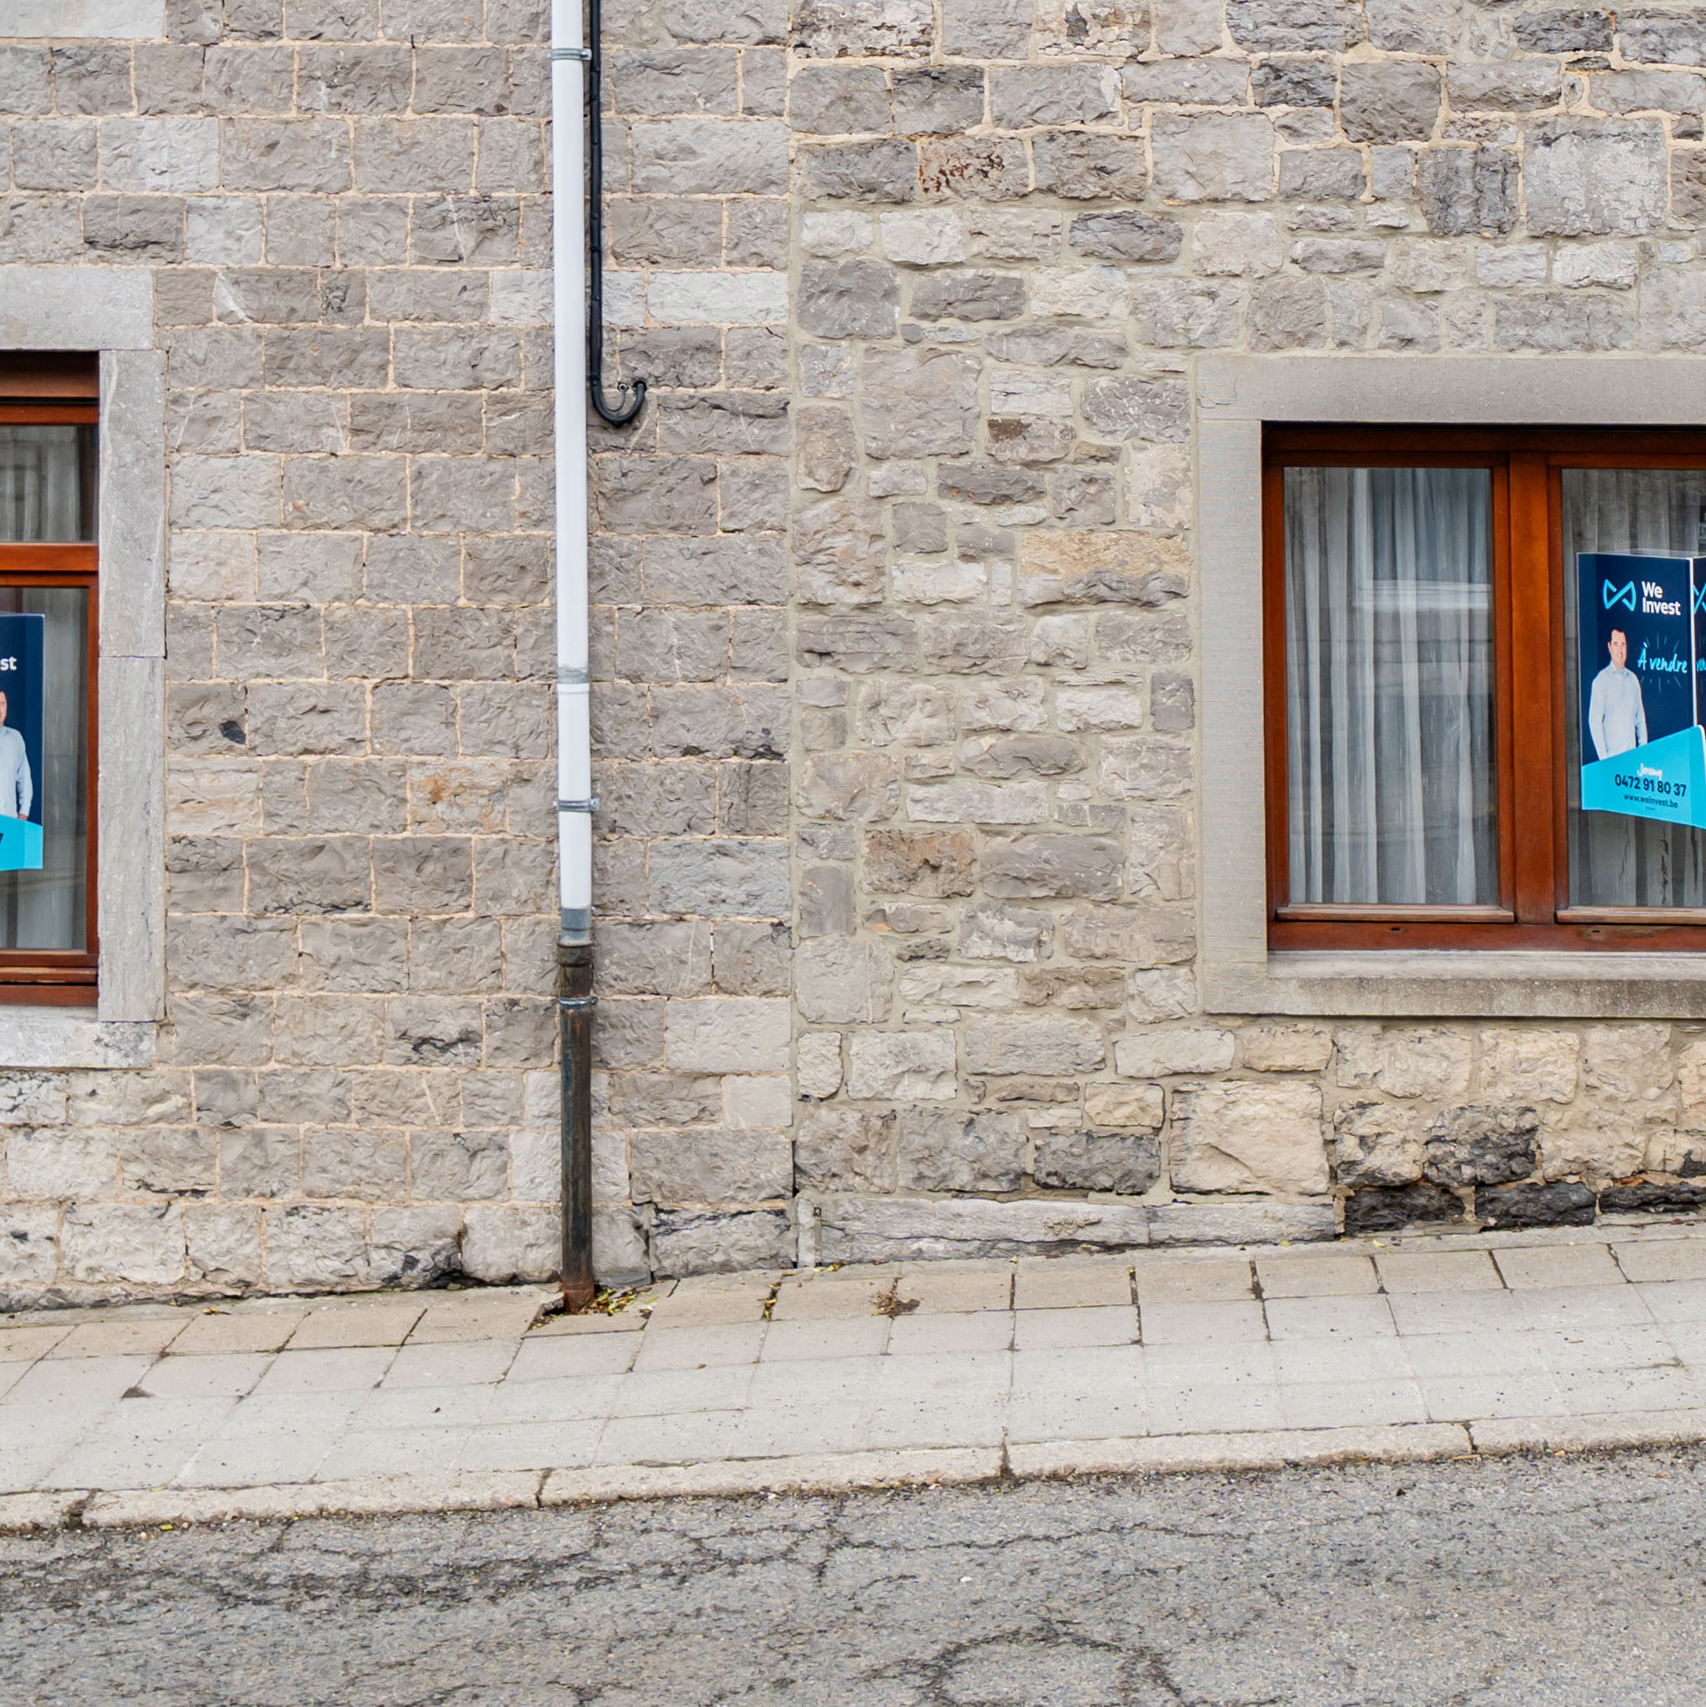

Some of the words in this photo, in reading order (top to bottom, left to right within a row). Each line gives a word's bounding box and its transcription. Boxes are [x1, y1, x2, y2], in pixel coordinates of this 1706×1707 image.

[1641, 580, 1663, 599] We
[1642, 596, 1681, 616] Invest
[1637, 641, 1648, 671] À
[1649, 653, 1687, 674] vendre
[1614, 774, 1640, 790] 0472
[1643, 778, 1654, 792] 91
[1657, 780, 1671, 794] 80
[1673, 783, 1687, 797] 37
[1624, 794, 1679, 809] www.weinvest.be
